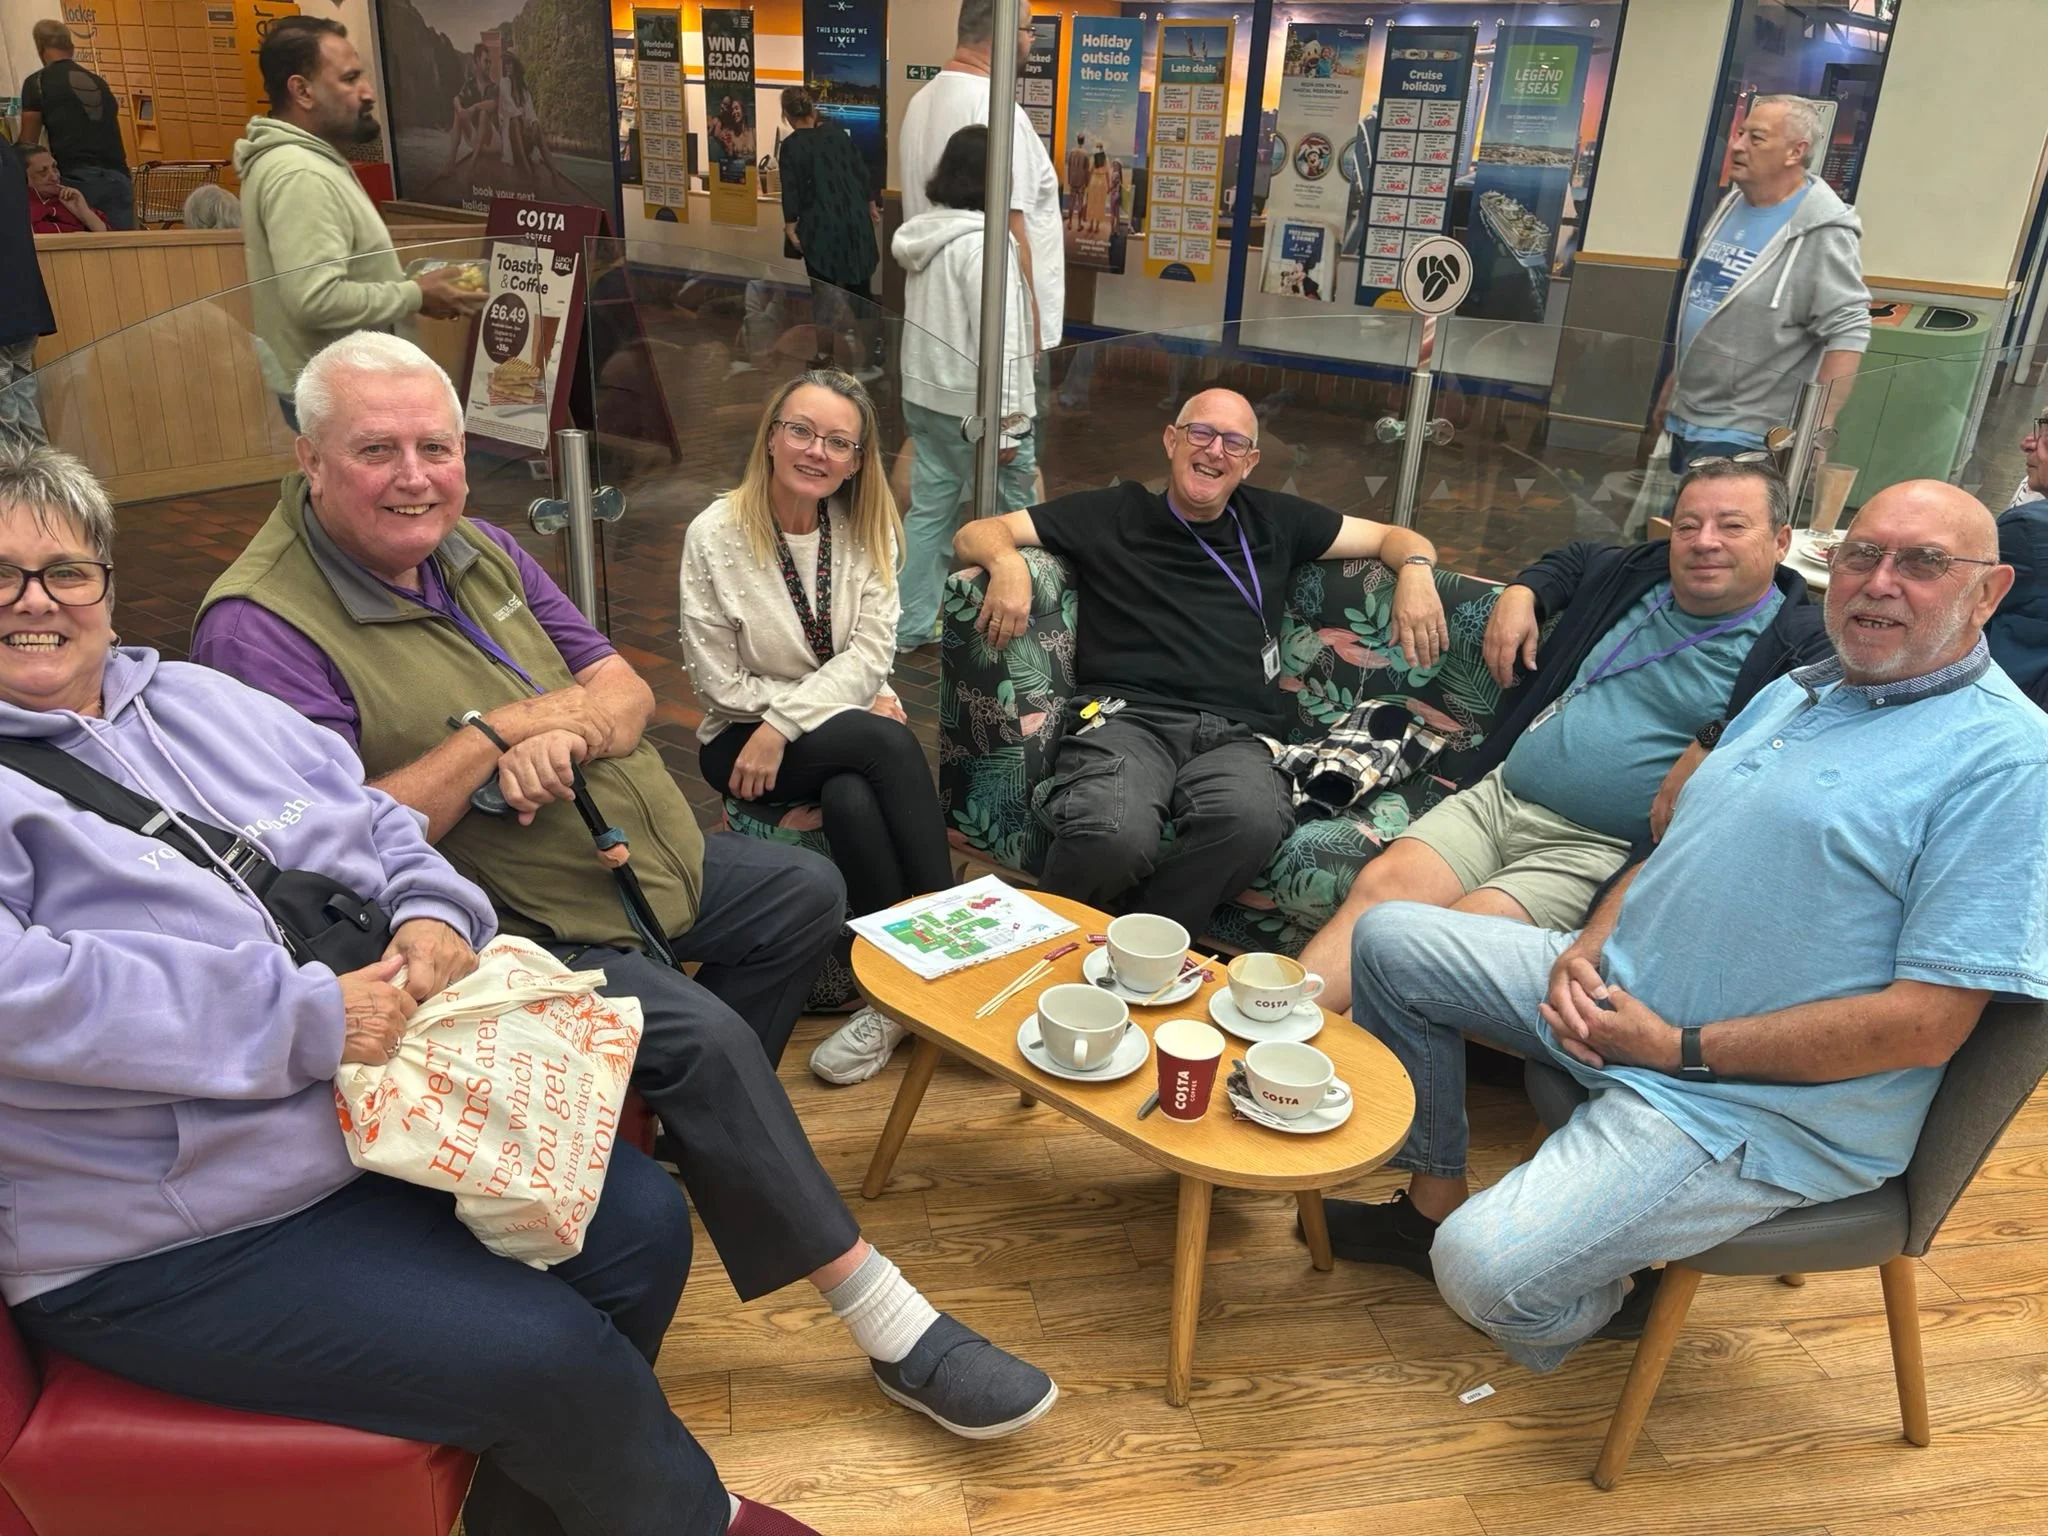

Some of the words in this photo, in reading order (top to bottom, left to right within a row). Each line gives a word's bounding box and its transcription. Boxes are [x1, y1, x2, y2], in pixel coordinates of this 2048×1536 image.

[64, 3, 96, 23] locker
[816, 26, 830, 34] THIS
[643, 40, 675, 49] Worldwide
[708, 36, 735, 52] WIN
[738, 37, 749, 53] A
[1082, 34, 1133, 51] Holiday
[646, 49, 672, 58] holidays
[708, 53, 750, 68] £2,500
[1081, 52, 1131, 65] outside
[708, 69, 751, 82] HOLIDAY
[1081, 67, 1102, 80] the
[1104, 68, 1129, 82] box
[1171, 64, 1191, 73] Late
[1192, 64, 1217, 73] deals
[1409, 69, 1443, 80] Cruise
[1514, 69, 1564, 81] LEGEND
[1402, 81, 1447, 93] holidays
[1526, 82, 1559, 95] SEAS
[473, 185, 493, 197] book
[496, 190, 516, 199] your
[517, 209, 565, 231] COSTA
[524, 232, 552, 243] COFFEE
[497, 253, 543, 275] Toastie
[554, 262, 572, 271] DEAL
[501, 274, 510, 288] &
[510, 276, 549, 294] Coffee
[490, 303, 526, 323] £6.49
[138, 846, 179, 871] yo
[502, 944, 535, 956] Shepard
[440, 991, 460, 1029] ad
[1255, 1000, 1289, 1009] COSTA
[542, 1054, 572, 1120] get,
[1175, 1070, 1190, 1110] COSTA
[1190, 1079, 1198, 1102] COFFEE
[1262, 1091, 1299, 1106] COSTA
[477, 1140, 522, 1198] ings
[509, 1052, 533, 1132] which
[505, 1195, 570, 1233] they're
[563, 1131, 585, 1192] things
[574, 1071, 594, 1132] which
[529, 1123, 559, 1198] you
[554, 1184, 598, 1246] get
[588, 1091, 617, 1172] you'
